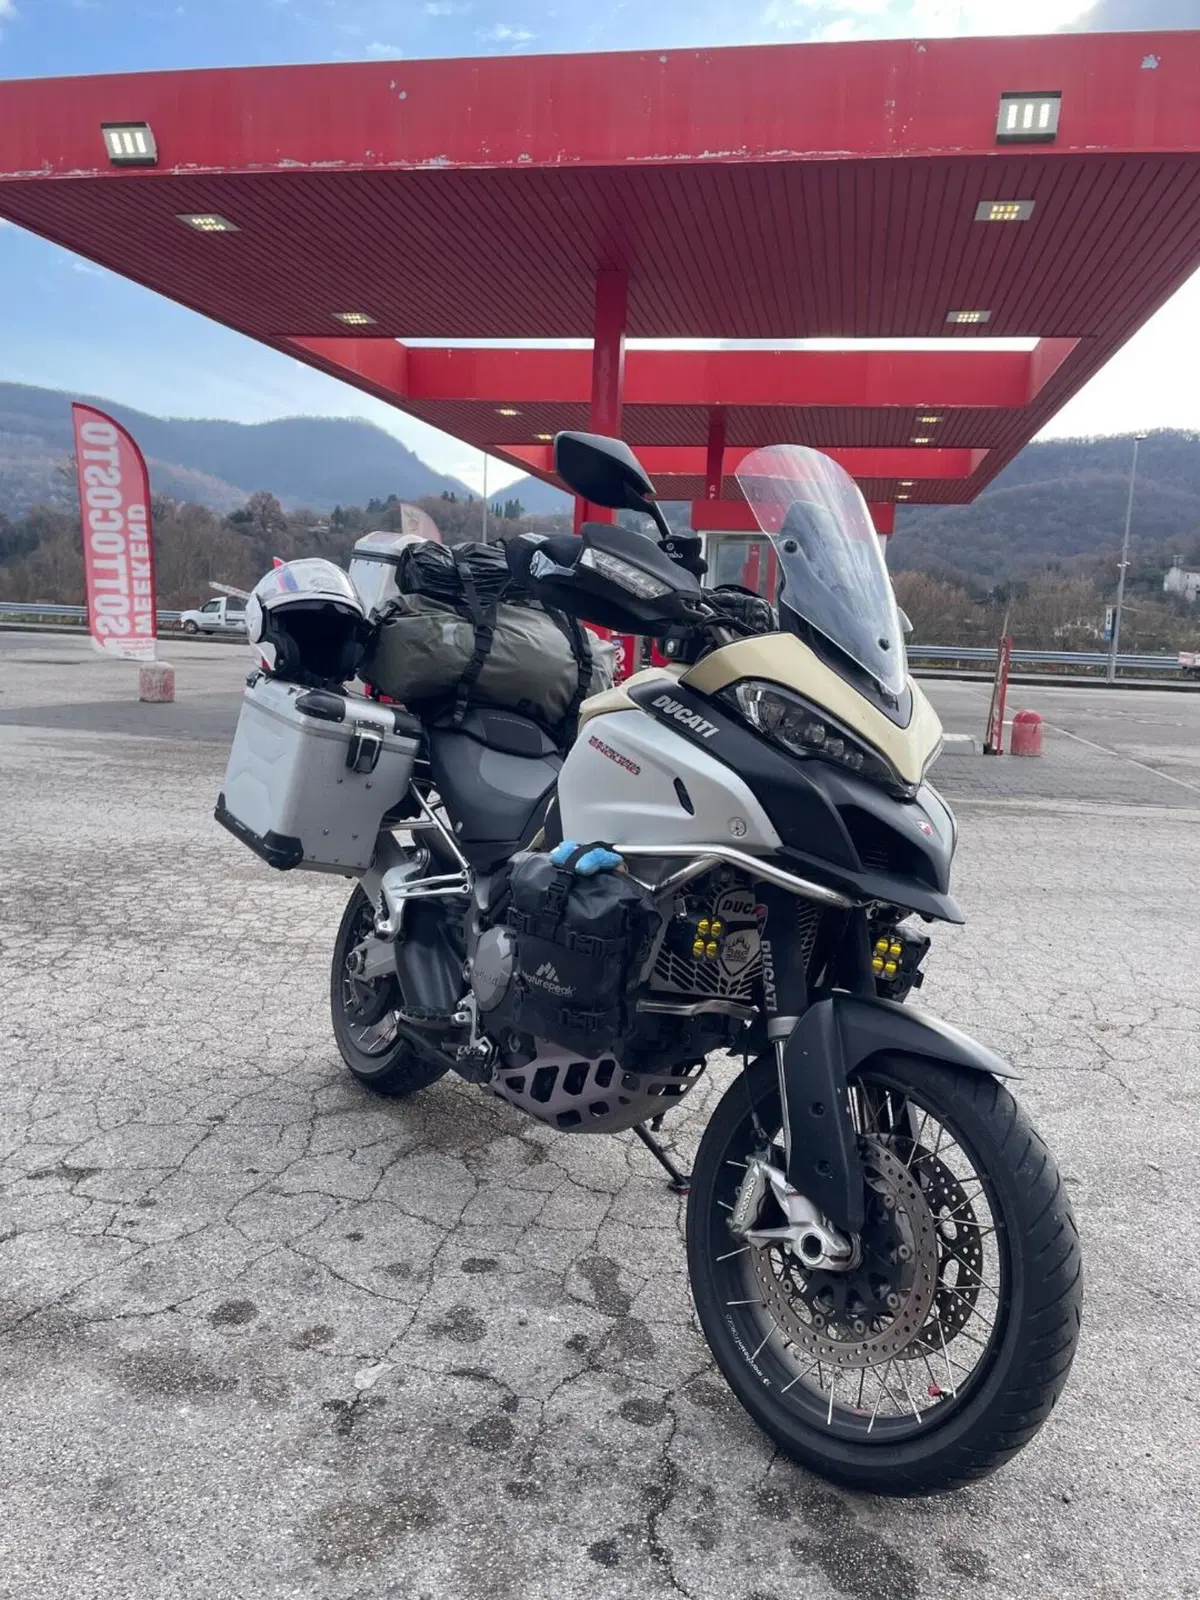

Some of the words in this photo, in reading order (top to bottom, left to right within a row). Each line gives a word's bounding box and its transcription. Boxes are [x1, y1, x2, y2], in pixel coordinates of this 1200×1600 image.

[652, 695, 720, 738] DUCATI
[761, 940, 778, 1011] DUCATI
[737, 1177, 756, 1222] brembo
